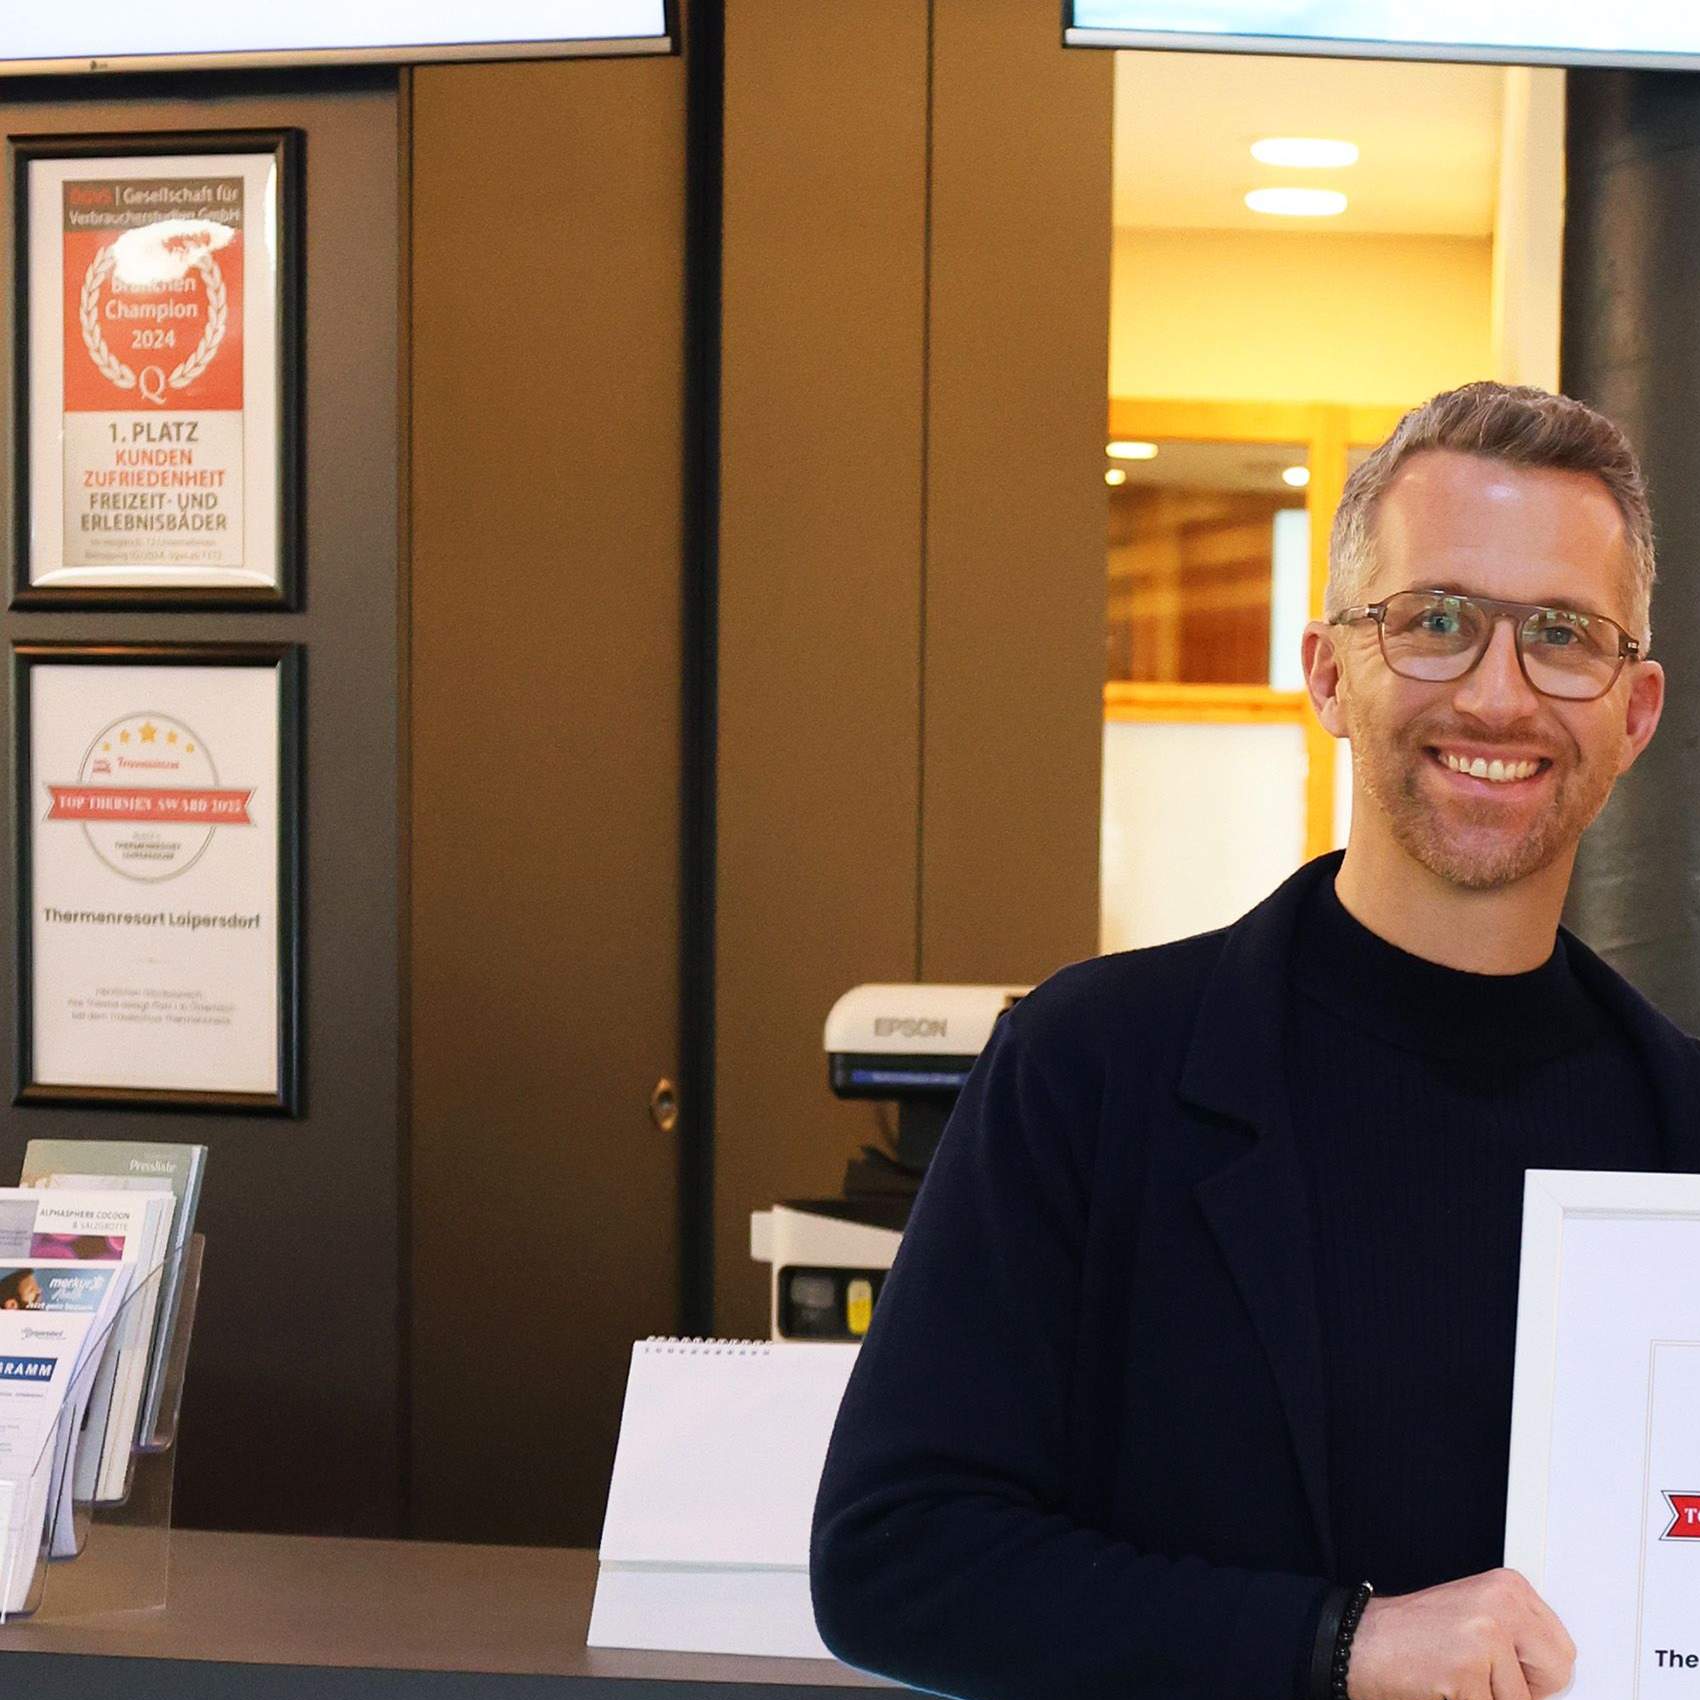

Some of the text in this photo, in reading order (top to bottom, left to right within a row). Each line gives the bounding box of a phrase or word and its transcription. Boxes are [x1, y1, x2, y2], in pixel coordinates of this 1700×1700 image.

[105, 298, 198, 322] Champion
[131, 328, 176, 350] 2024
[139, 365, 167, 404] Q
[109, 422, 199, 443] 1. PLATZ
[115, 449, 193, 466] KUNDEN
[84, 469, 225, 487] ZUFRIEDENHEIT
[89, 492, 218, 510] FREIZEIT- UND
[874, 1018, 948, 1037] EPSON
